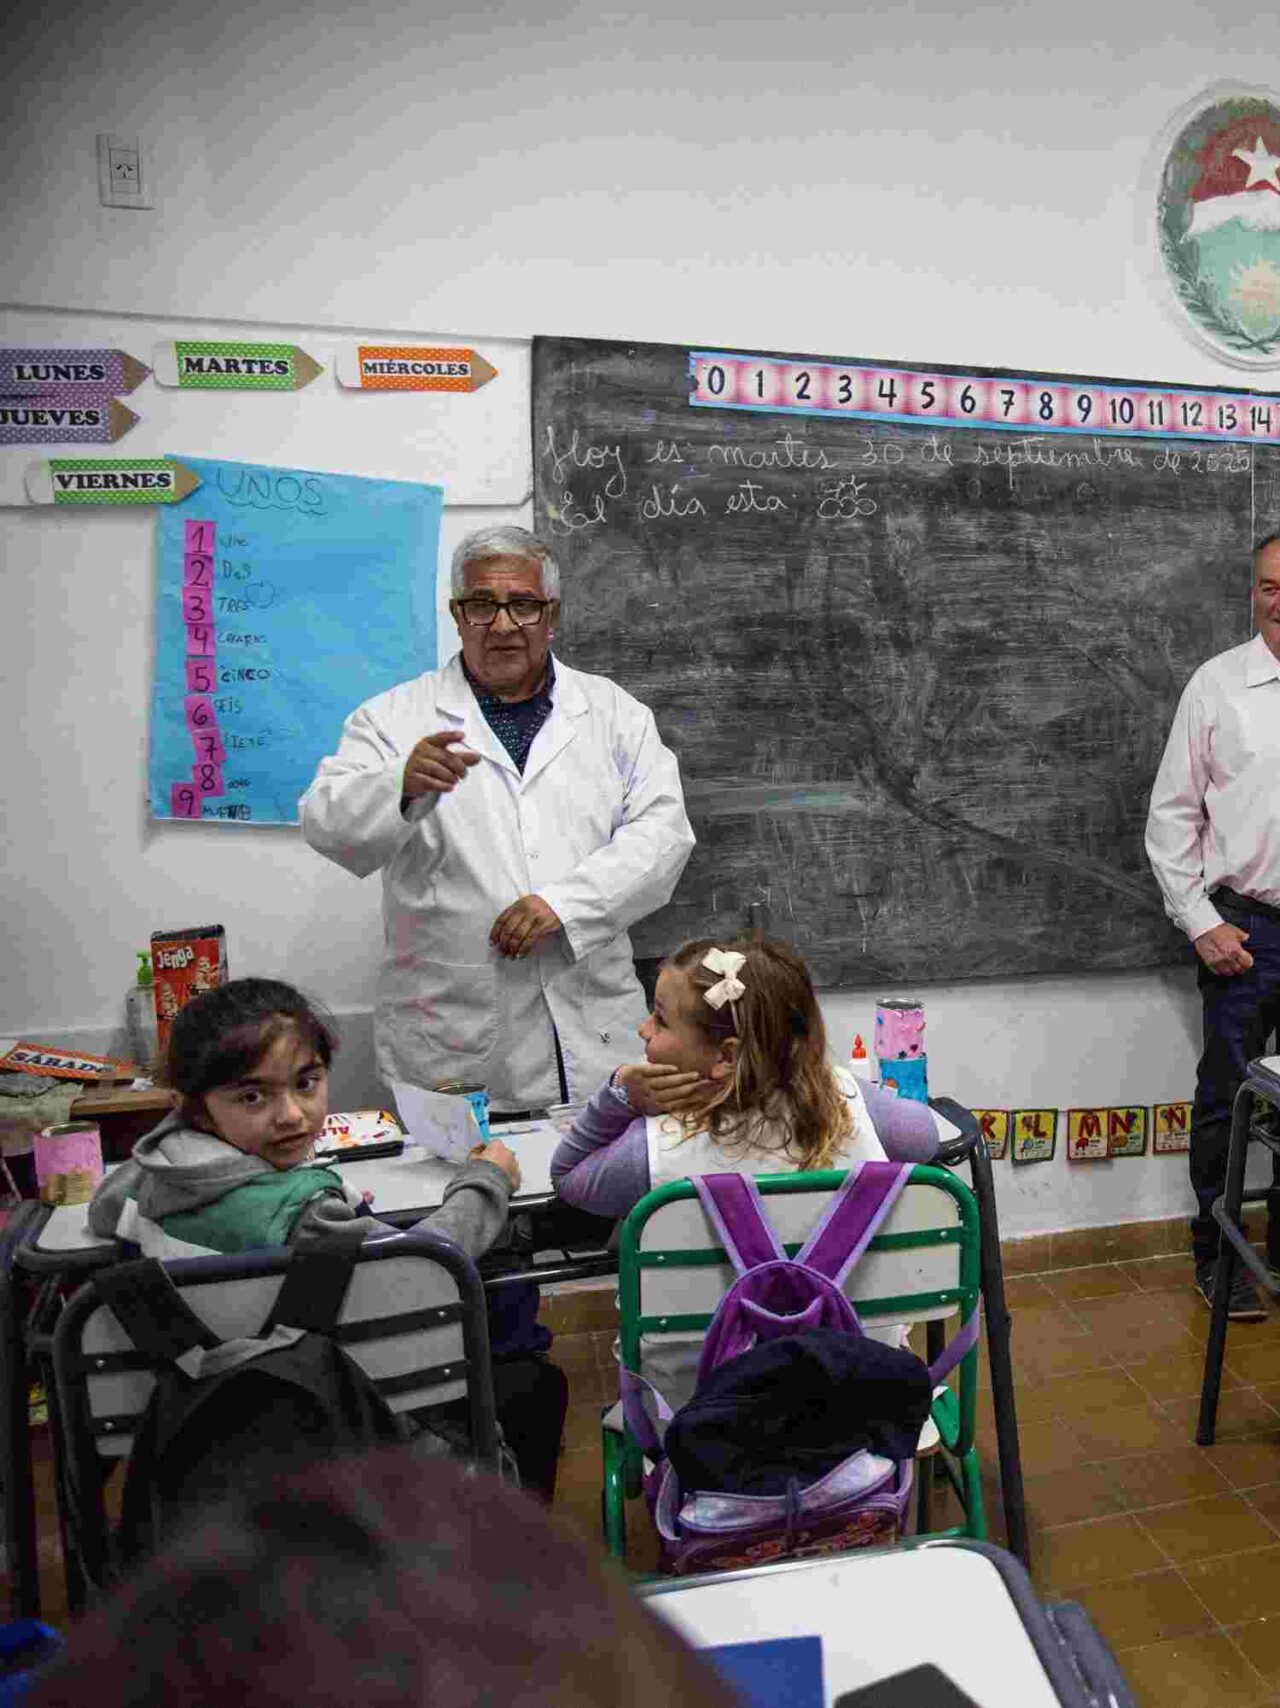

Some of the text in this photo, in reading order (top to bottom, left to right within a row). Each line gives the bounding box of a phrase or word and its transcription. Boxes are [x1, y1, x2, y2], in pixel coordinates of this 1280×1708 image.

[14, 364, 105, 381] LUNES
[184, 356, 290, 376] MARTES
[362, 358, 470, 376] MIÉRCOLES
[706, 365, 725, 395] 0
[756, 370, 764, 397] 1
[795, 372, 811, 400] 2
[839, 375, 852, 403] 3
[878, 378, 896, 407] 4
[920, 381, 935, 409] 5
[960, 384, 976, 413] 6
[1001, 390, 1016, 417] 7
[1039, 392, 1053, 420] 8
[1077, 394, 1093, 422] 9
[1110, 397, 1134, 424] 10
[1148, 400, 1164, 426] 11
[1180, 401, 1202, 427] 12
[1218, 405, 1237, 431] 13
[1249, 406, 1271, 433] 14
[0, 409, 100, 426] JUEVES
[542, 425, 627, 497] Hoy
[649, 439, 685, 464] es
[709, 433, 839, 469] martes
[861, 440, 905, 467] 30
[920, 436, 954, 466] de
[56, 471, 172, 490] VIERNES
[191, 526, 205, 552] 1
[190, 560, 208, 586] 2
[188, 597, 205, 621] 3
[193, 627, 208, 653] 4
[197, 666, 210, 692] 5
[193, 704, 207, 725] 6
[199, 737, 217, 760] 7
[200, 764, 216, 791] 8
[179, 789, 194, 816] 9
[157, 945, 194, 970] Jenga
[981, 1113, 997, 1139] K
[1033, 1113, 1047, 1137] L
[1078, 1112, 1101, 1137] M
[1110, 1110, 1131, 1135] N
